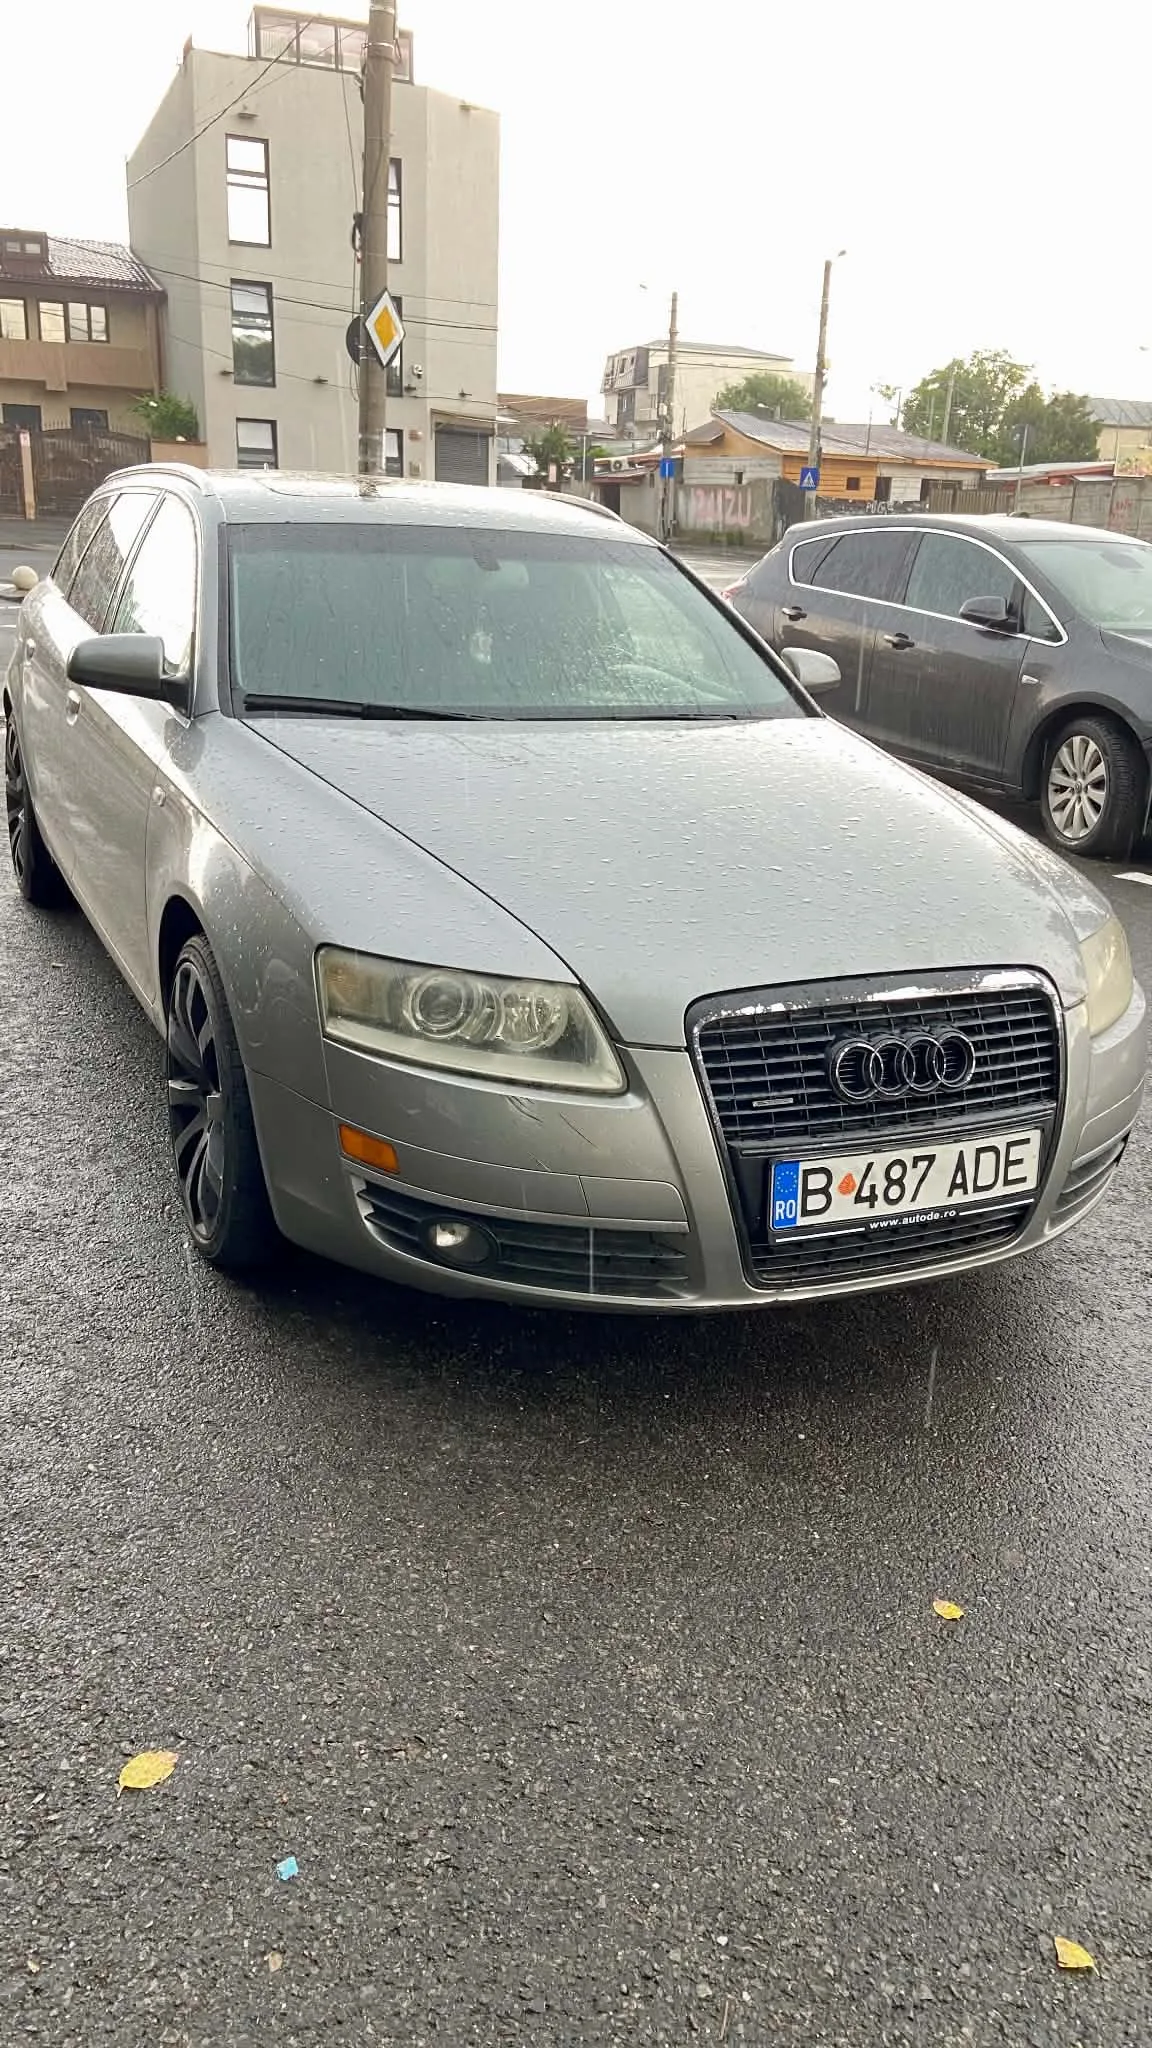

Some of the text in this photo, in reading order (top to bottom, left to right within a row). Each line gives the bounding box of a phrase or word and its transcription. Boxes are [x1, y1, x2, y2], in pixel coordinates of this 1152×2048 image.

[801, 1137, 1031, 1217] B 487 ADE
[775, 1200, 796, 1220] RO
[869, 1210, 956, 1229] www.autode.ro
